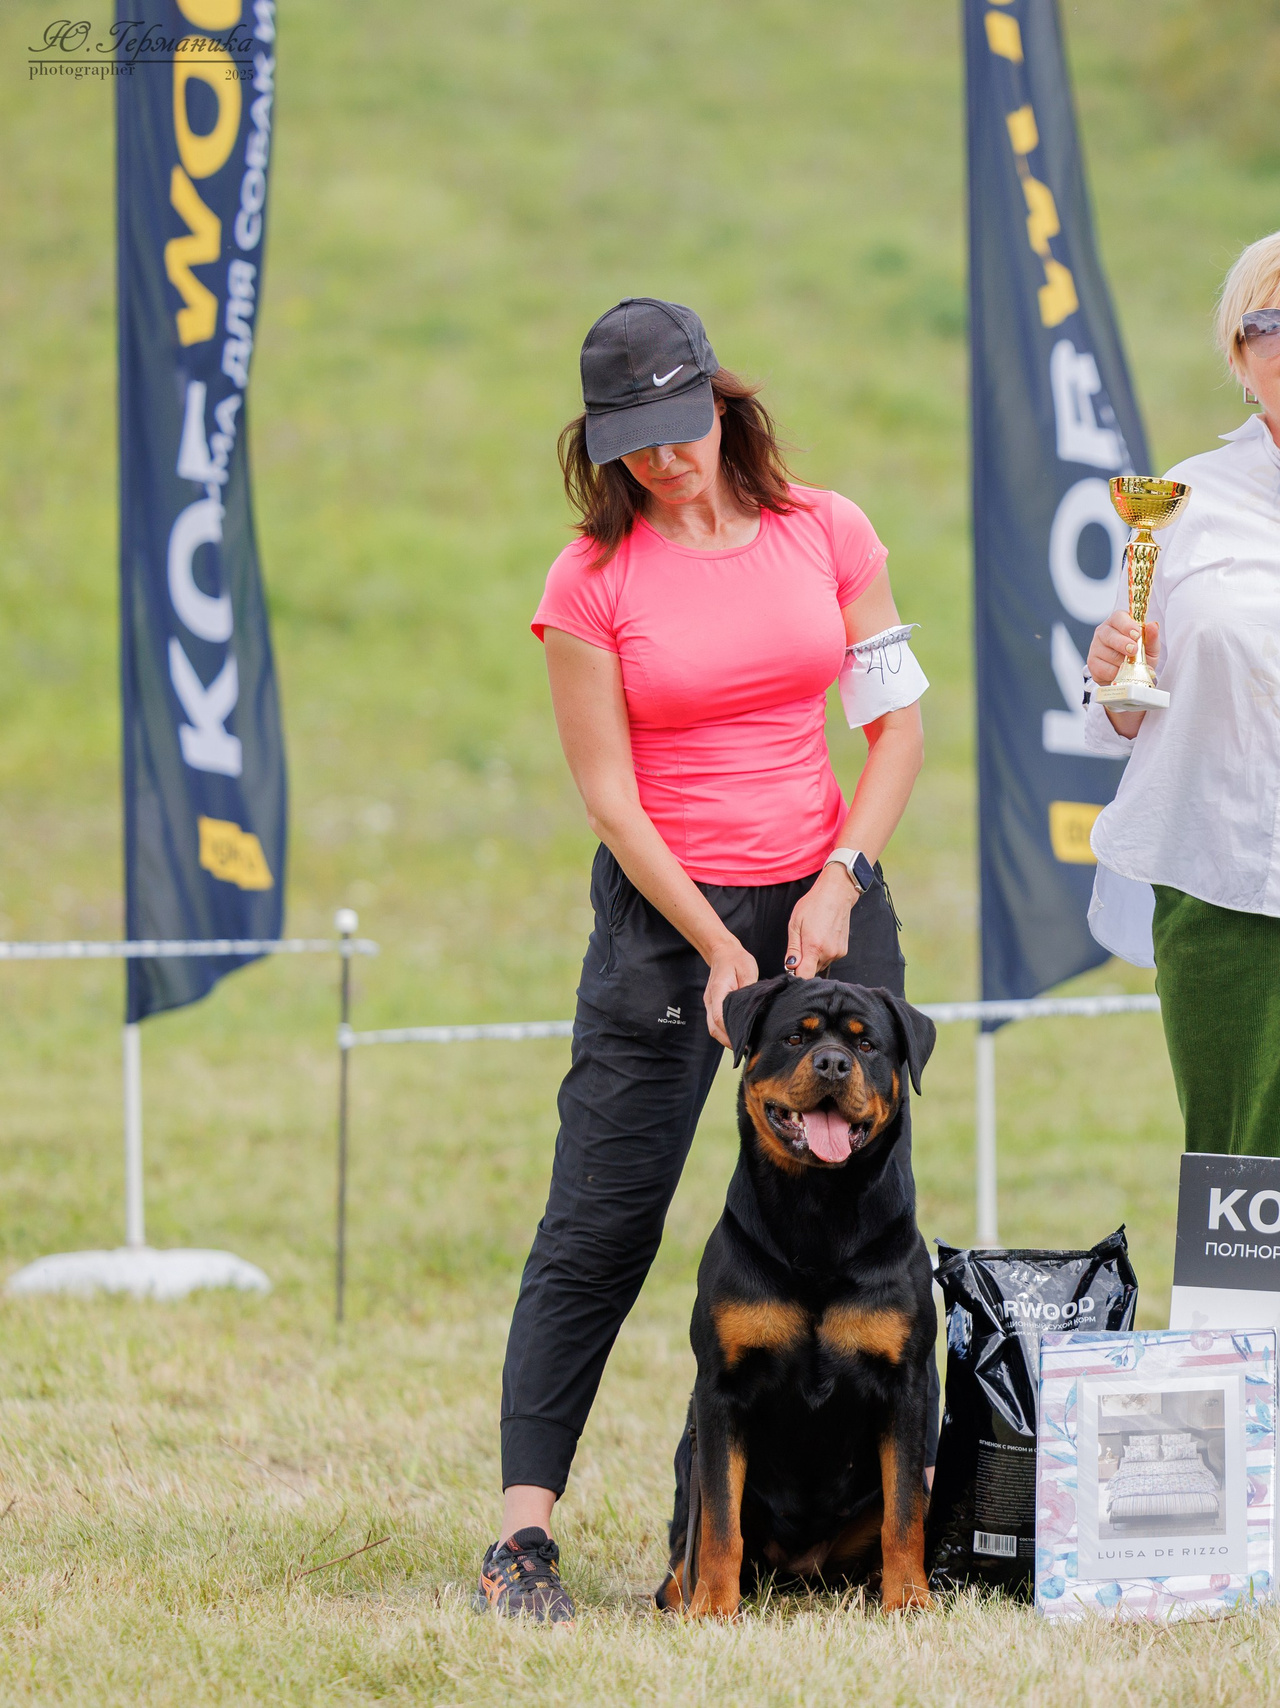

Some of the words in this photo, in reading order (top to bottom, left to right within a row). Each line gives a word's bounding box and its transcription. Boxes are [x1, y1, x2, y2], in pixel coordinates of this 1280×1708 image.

[234, 51, 275, 251] СОБАК
[1002, 1296, 1095, 1320] RWOOD
[1048, 1320, 1073, 1331] СУХОЙ
[1073, 1316, 1096, 1326] КОРМ
[1097, 1549, 1146, 1560] LUISA
[1154, 1548, 1174, 1557] DE
[1182, 1546, 1229, 1556] RIZZO
